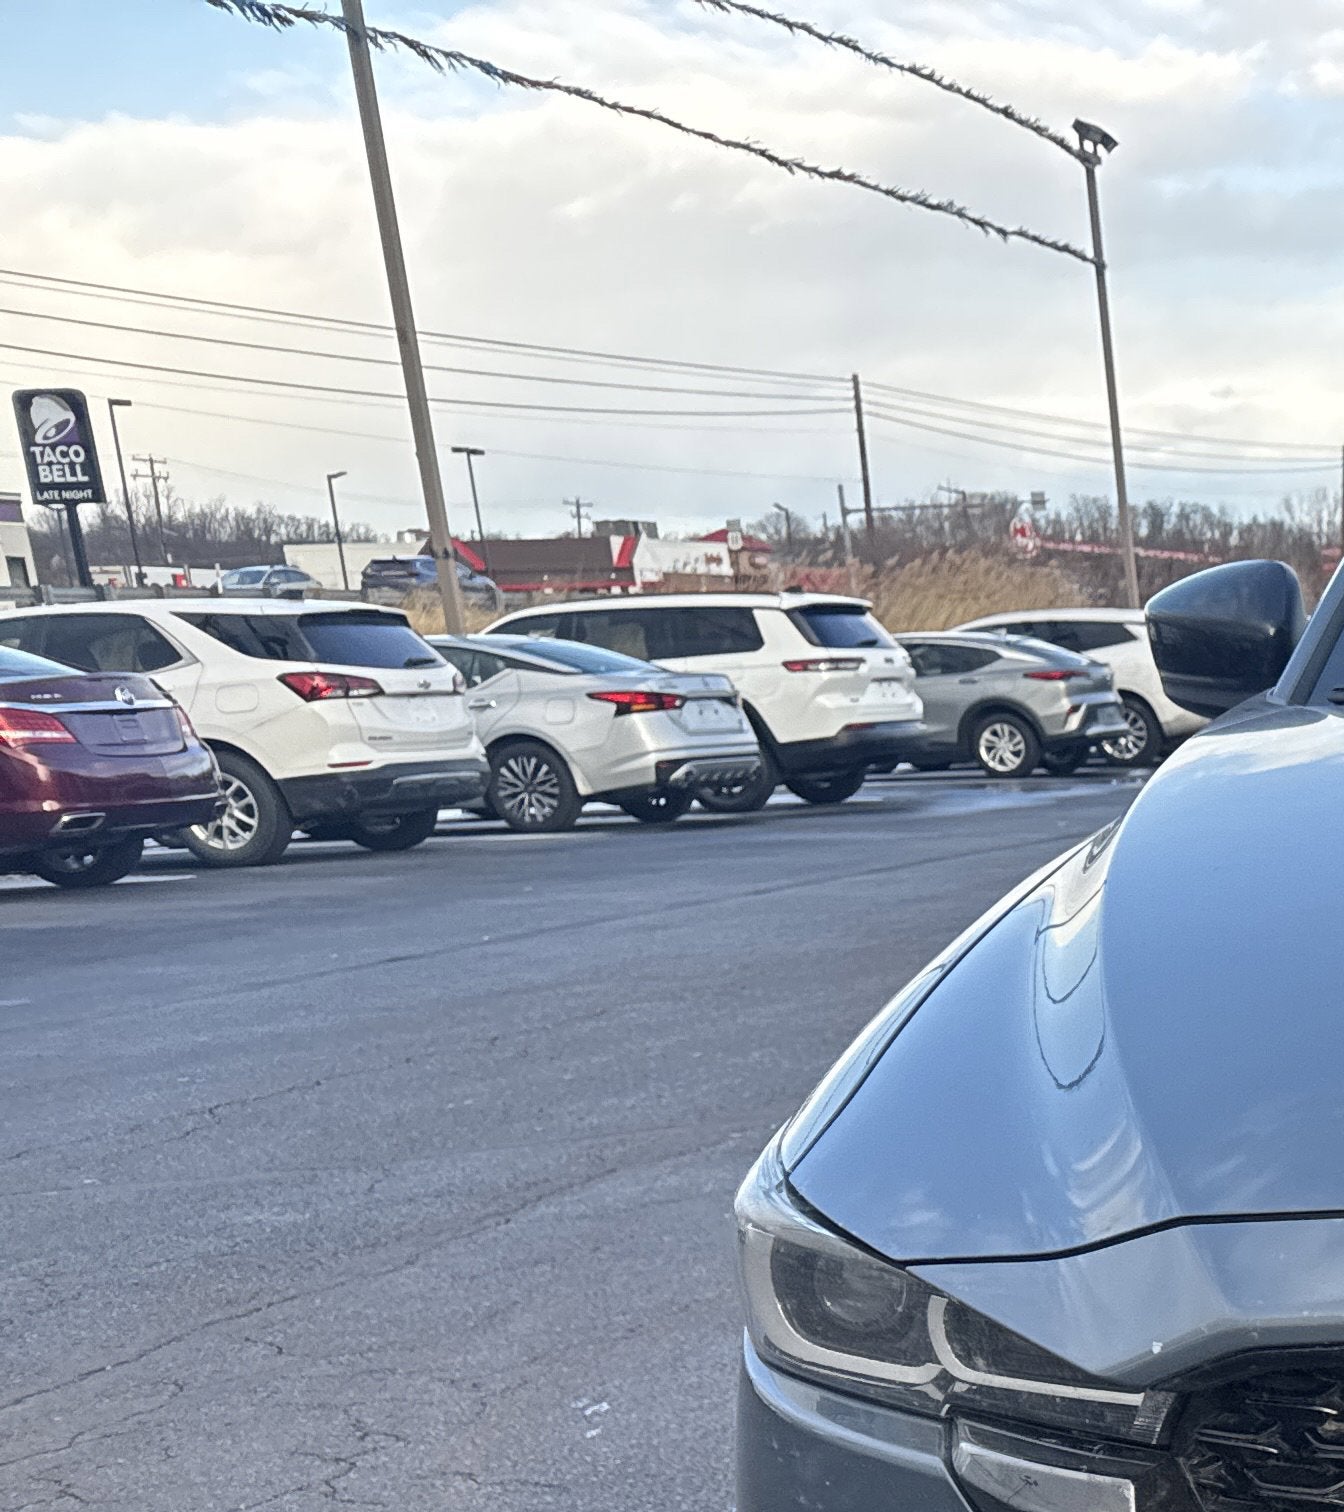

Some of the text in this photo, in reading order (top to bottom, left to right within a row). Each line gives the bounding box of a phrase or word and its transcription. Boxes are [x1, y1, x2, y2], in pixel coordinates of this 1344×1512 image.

[30, 445, 85, 464] TACO
[38, 465, 89, 483] BELL
[36, 489, 93, 500] LATE NIGHT
